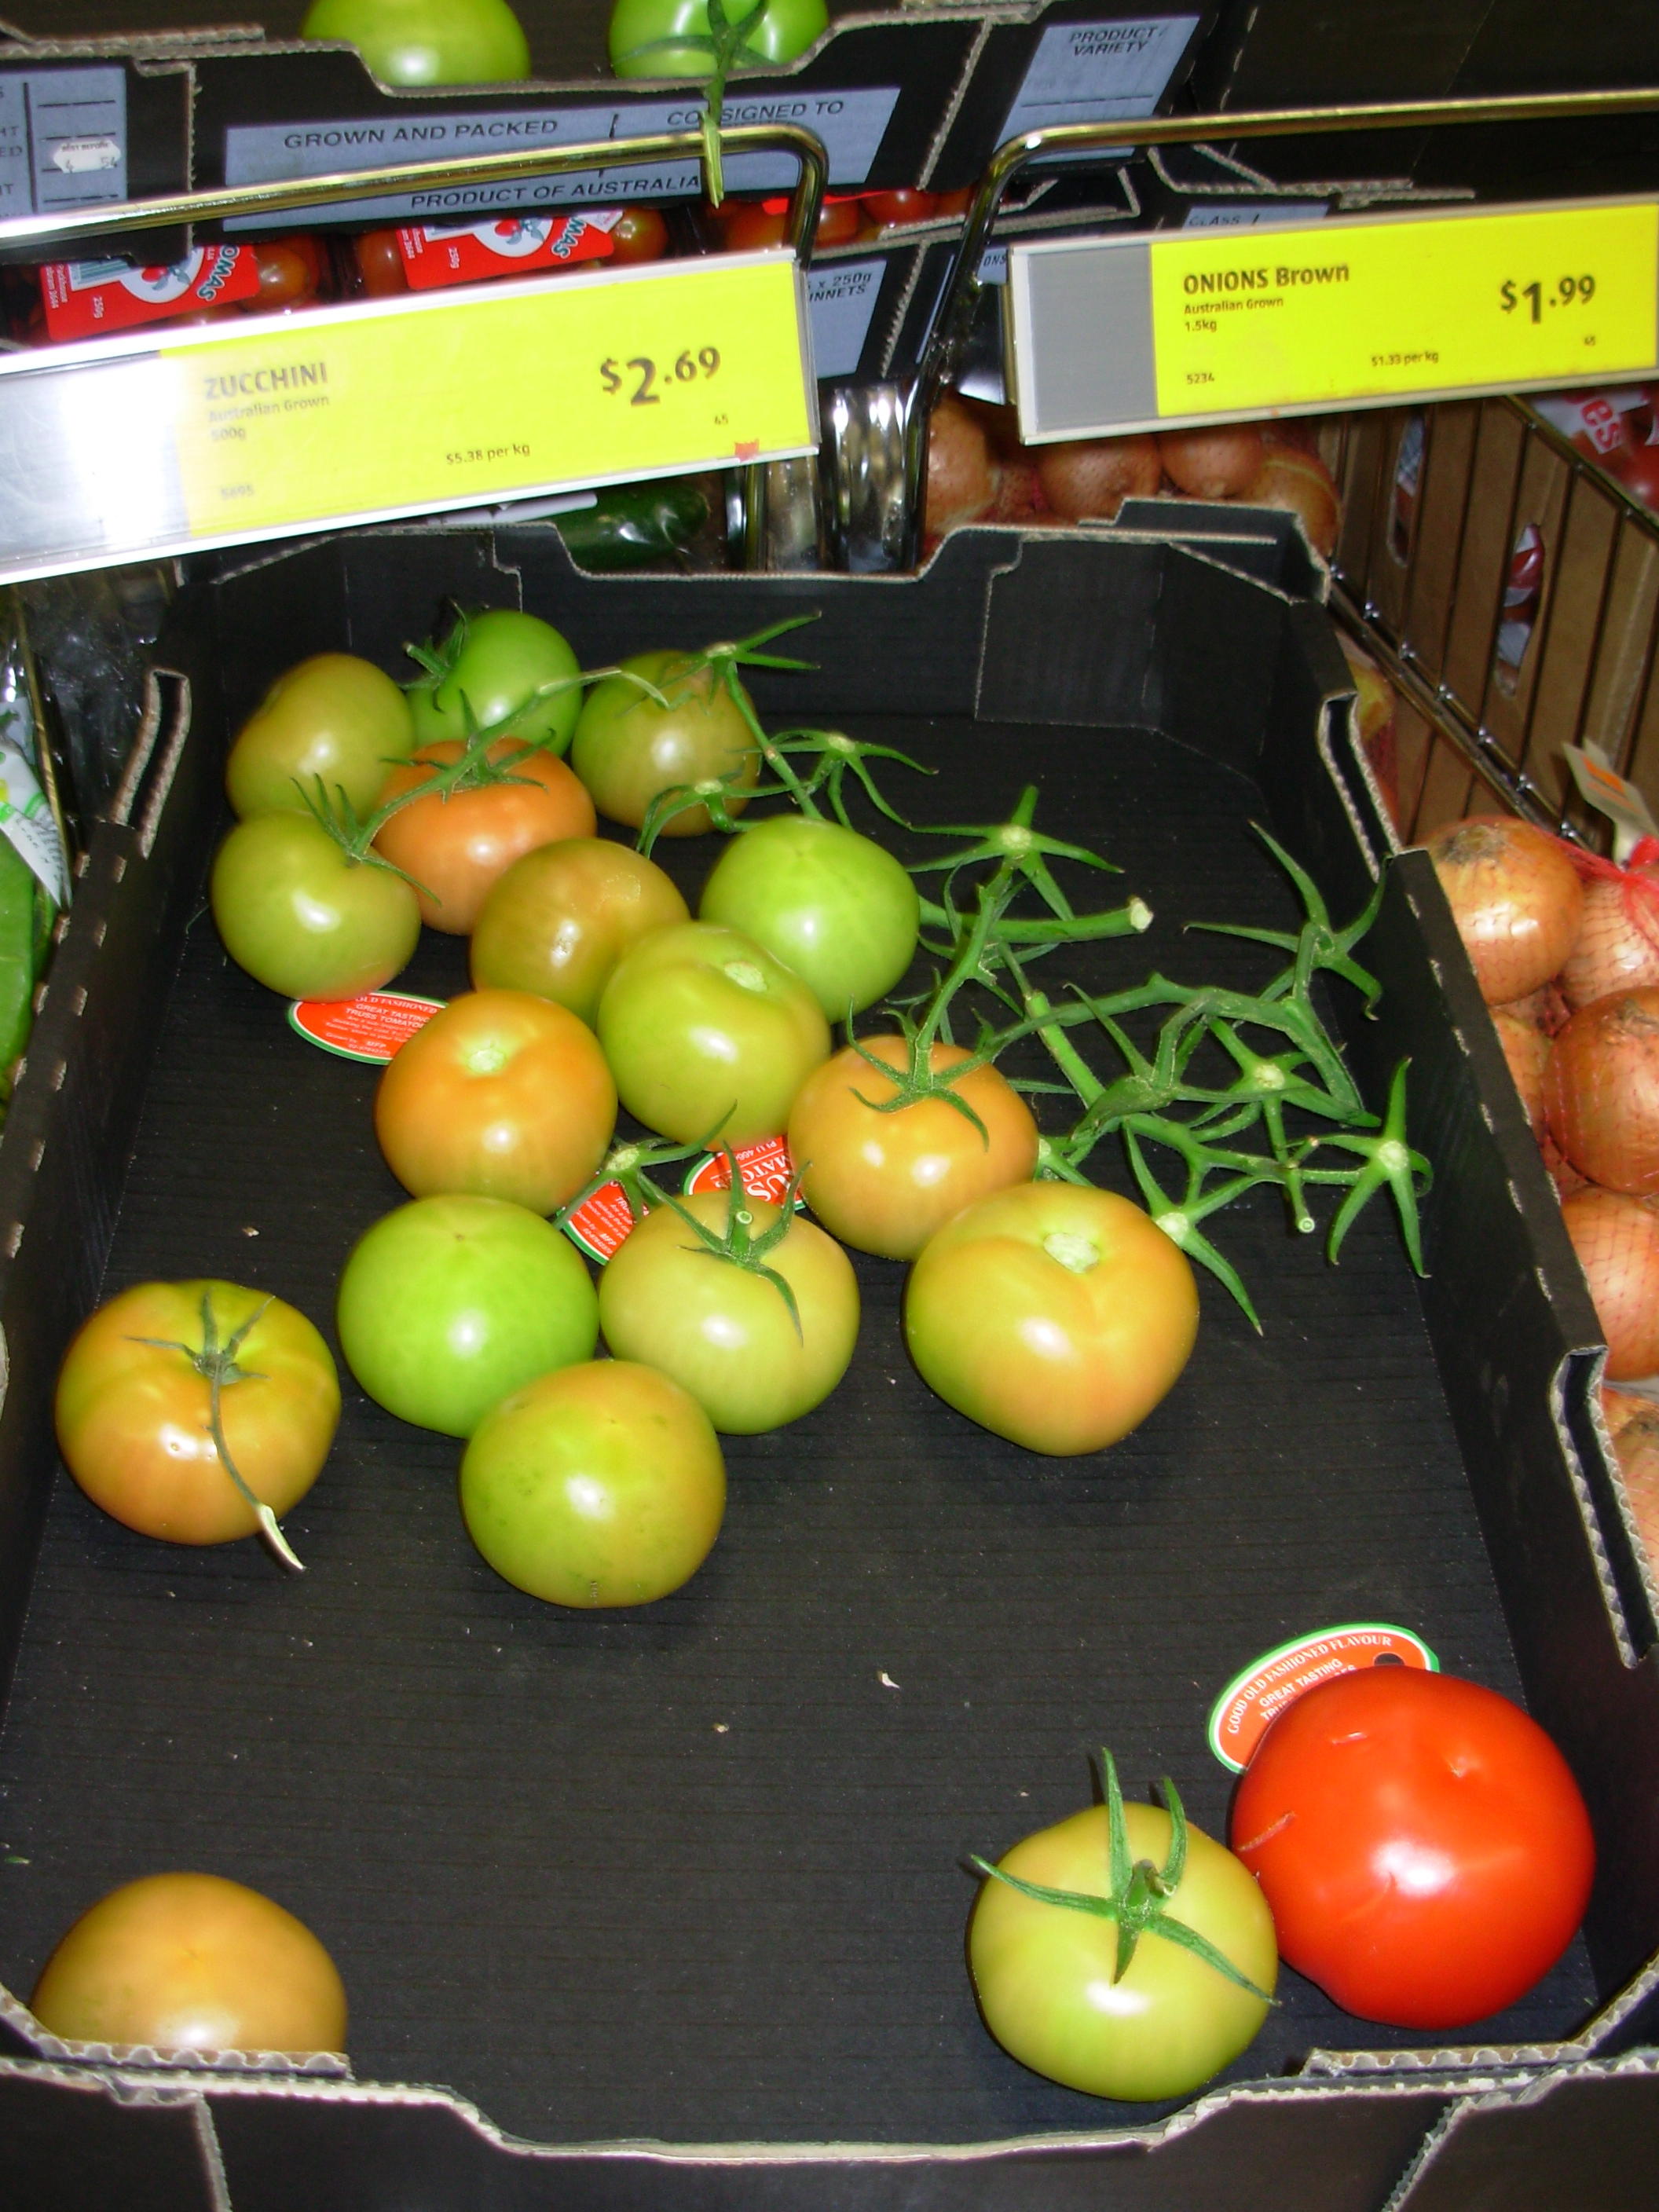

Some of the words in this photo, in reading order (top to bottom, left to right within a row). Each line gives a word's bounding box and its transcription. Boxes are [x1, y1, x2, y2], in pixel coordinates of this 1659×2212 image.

[1073, 41, 1148, 57] VARIETY
[667, 103, 808, 126] COSIGNED
[815, 101, 844, 115] TO
[284, 130, 384, 148] GROWN
[394, 125, 446, 141] AND
[455, 120, 558, 137] PACKED
[411, 188, 527, 208] PRODUCT
[533, 185, 567, 198] OF
[571, 174, 701, 197] AUSTRALIA
[1183, 268, 1269, 295] ONIONS
[1276, 262, 1350, 287] Brown
[1184, 299, 1243, 316] Australian
[1246, 296, 1284, 309] Grown
[1500, 273, 1596, 325] $1.99
[1185, 319, 1218, 333] 1.5kg
[1404, 353, 1423, 367] per
[1424, 350, 1440, 364] kg
[204, 362, 328, 401] ZUCCHINI
[599, 346, 722, 407] $2.69
[1186, 372, 1215, 385] 5234
[209, 403, 280, 423] Australian
[284, 394, 330, 412] Grown
[446, 449, 483, 466] $5.38
[487, 445, 510, 463] per
[513, 442, 531, 458] kg
[346, 1008, 377, 1020] TRUSS
[356, 1003, 388, 1015] GREAT
[1226, 1700, 1247, 1734] GOOD
[1243, 1675, 1267, 1701] OLD
[1265, 1643, 1329, 1683] FASHIONED
[1331, 1635, 1392, 1652] FLAVOUR
[1258, 1683, 1296, 1708] GREAT
[1296, 1658, 1343, 1687] TASTING
